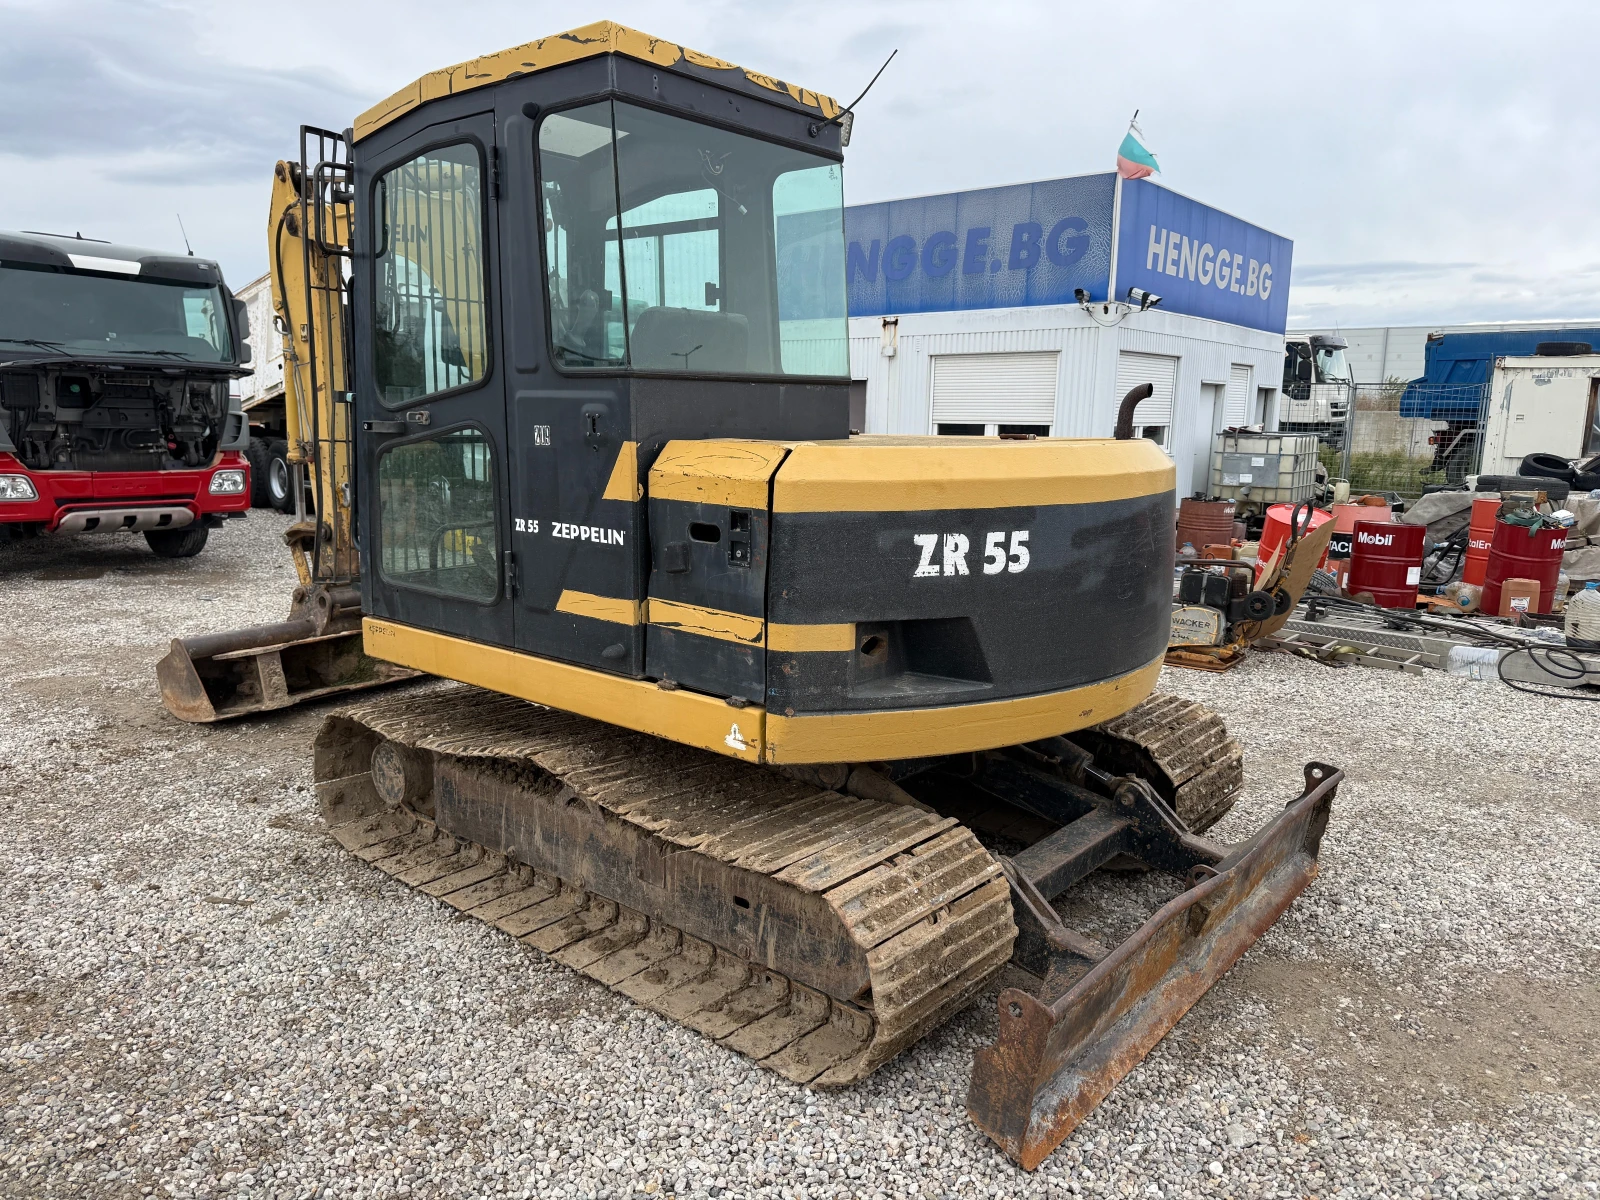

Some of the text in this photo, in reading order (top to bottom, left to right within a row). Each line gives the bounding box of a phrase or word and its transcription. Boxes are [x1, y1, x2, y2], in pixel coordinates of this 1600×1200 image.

[1146, 224, 1273, 301] HENGGE.BG
[515, 518, 539, 533] ZR 55
[551, 521, 625, 546] ZEPPELIN
[1357, 531, 1394, 546] Mobil
[913, 530, 1031, 578] ZR 55
[1171, 617, 1212, 629] WACKER
